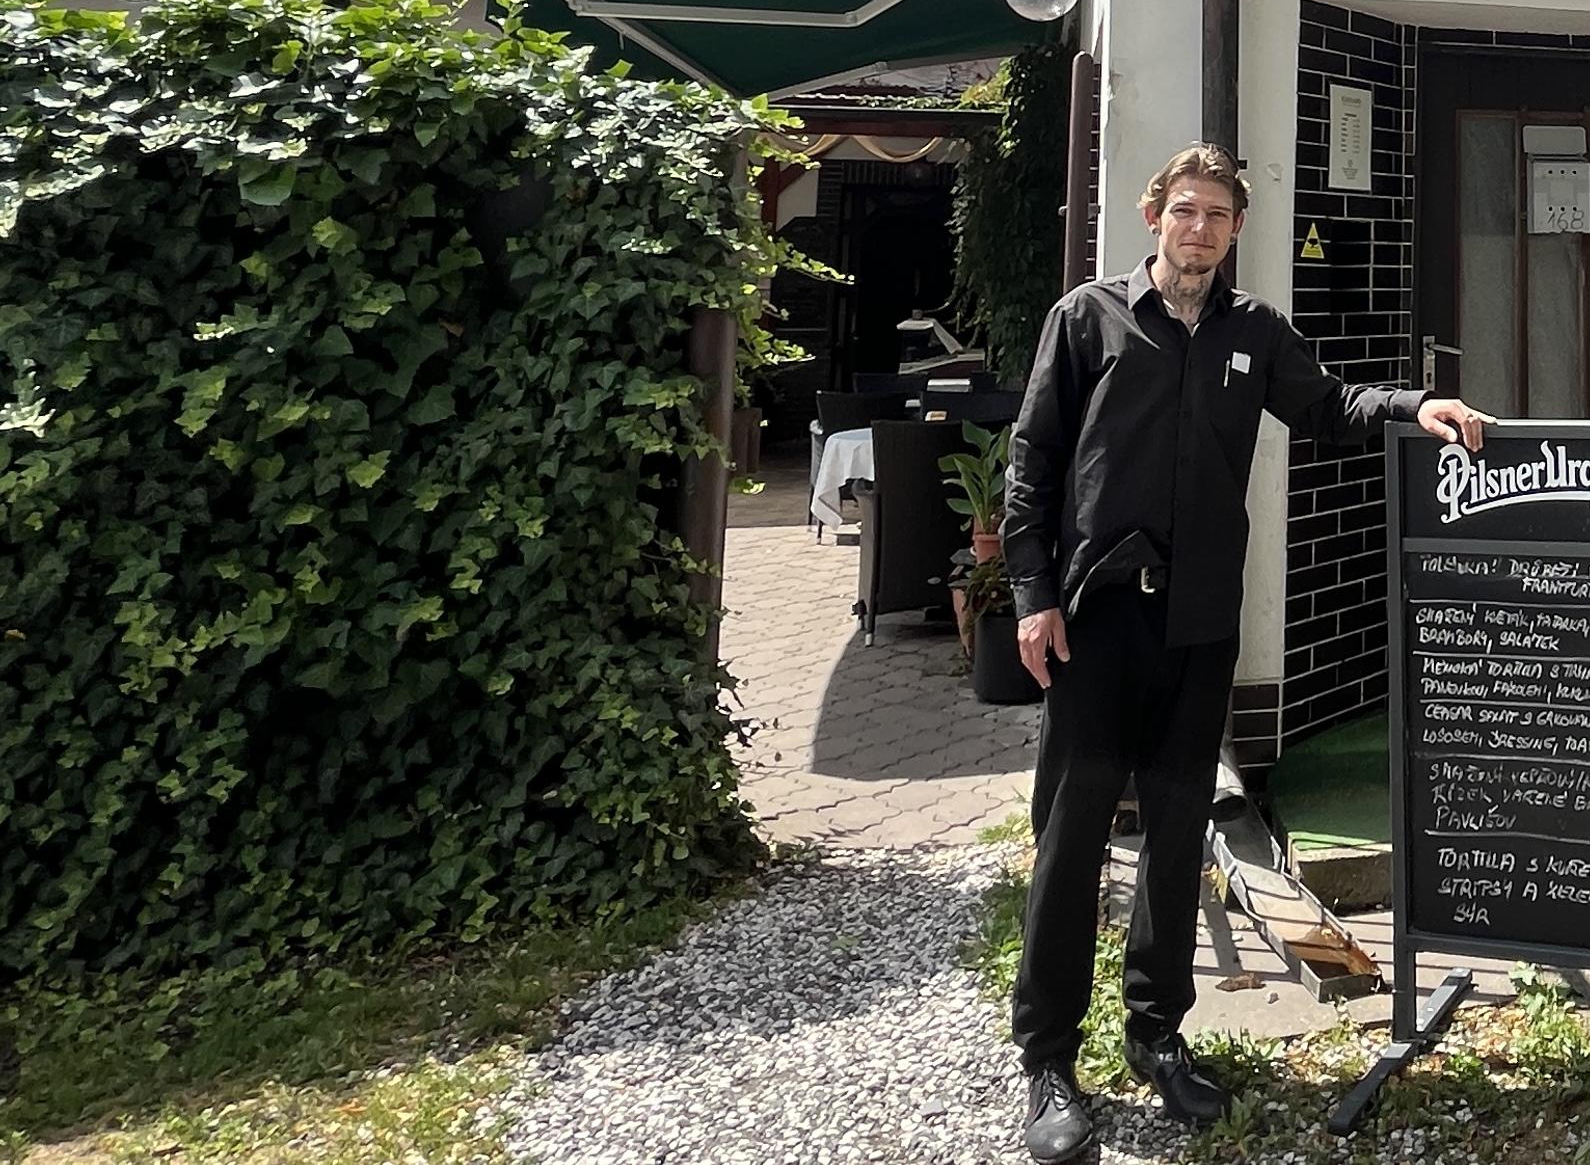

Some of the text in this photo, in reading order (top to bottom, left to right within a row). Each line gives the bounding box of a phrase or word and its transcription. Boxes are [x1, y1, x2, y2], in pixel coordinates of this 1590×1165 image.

[1547, 209, 1585, 231] 168
[1436, 442, 1546, 523] Pilsner
[1522, 881, 1539, 901] A
